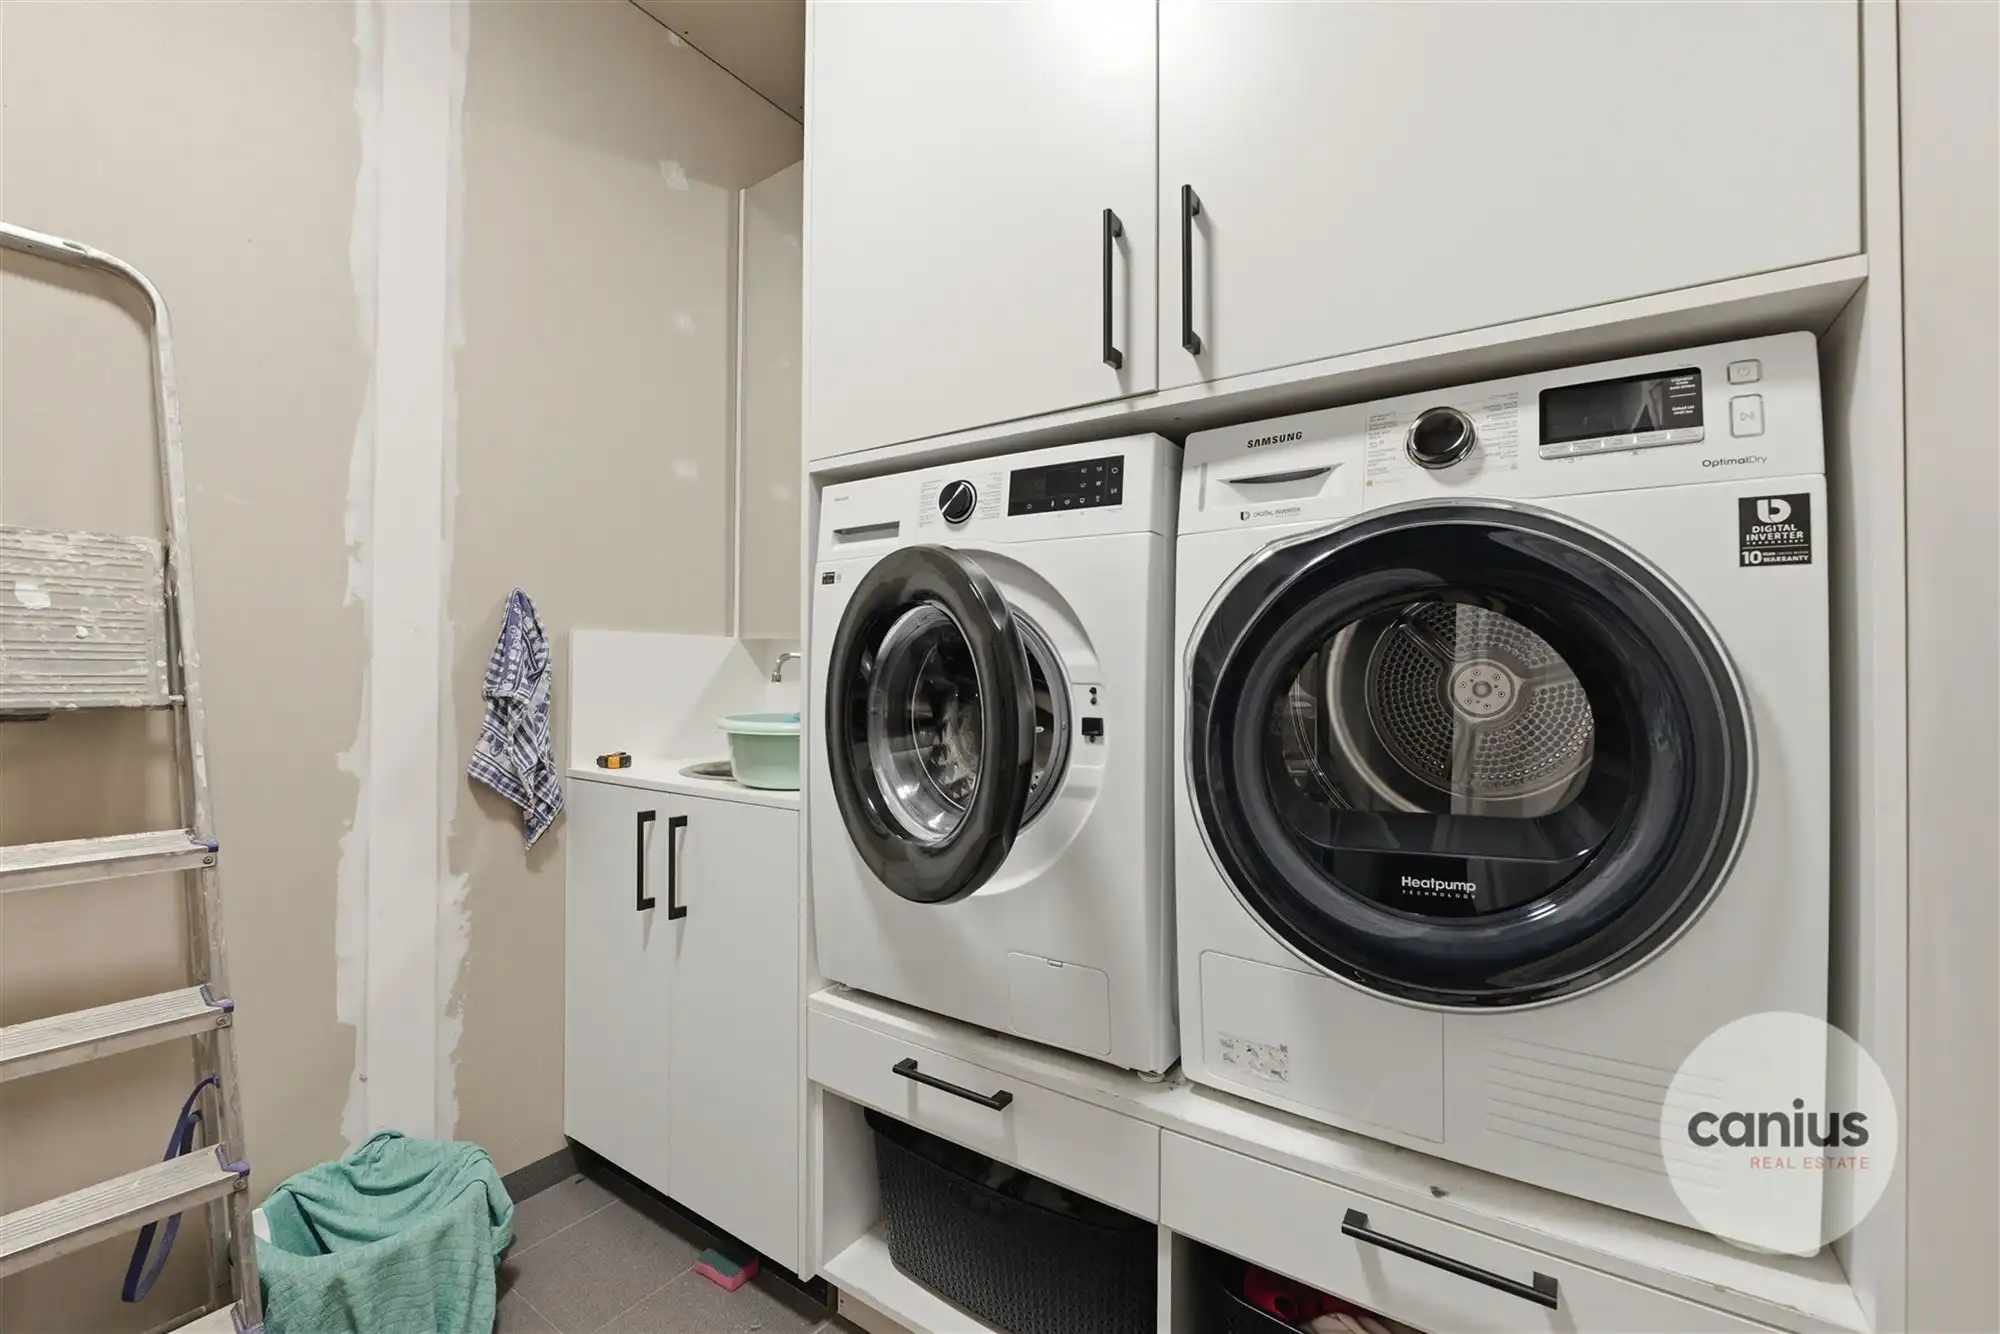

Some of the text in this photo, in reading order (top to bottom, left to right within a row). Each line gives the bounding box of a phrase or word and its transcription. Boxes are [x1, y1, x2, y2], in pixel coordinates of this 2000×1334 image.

[1247, 431, 1303, 448] SAMSUNG
[1752, 524, 1798, 533] DIGITAL
[1746, 531, 1804, 541] INVERTER
[1742, 550, 1762, 564] 10
[1401, 876, 1476, 893] Heatpump
[1402, 889, 1475, 899] TECHNOLOGY
